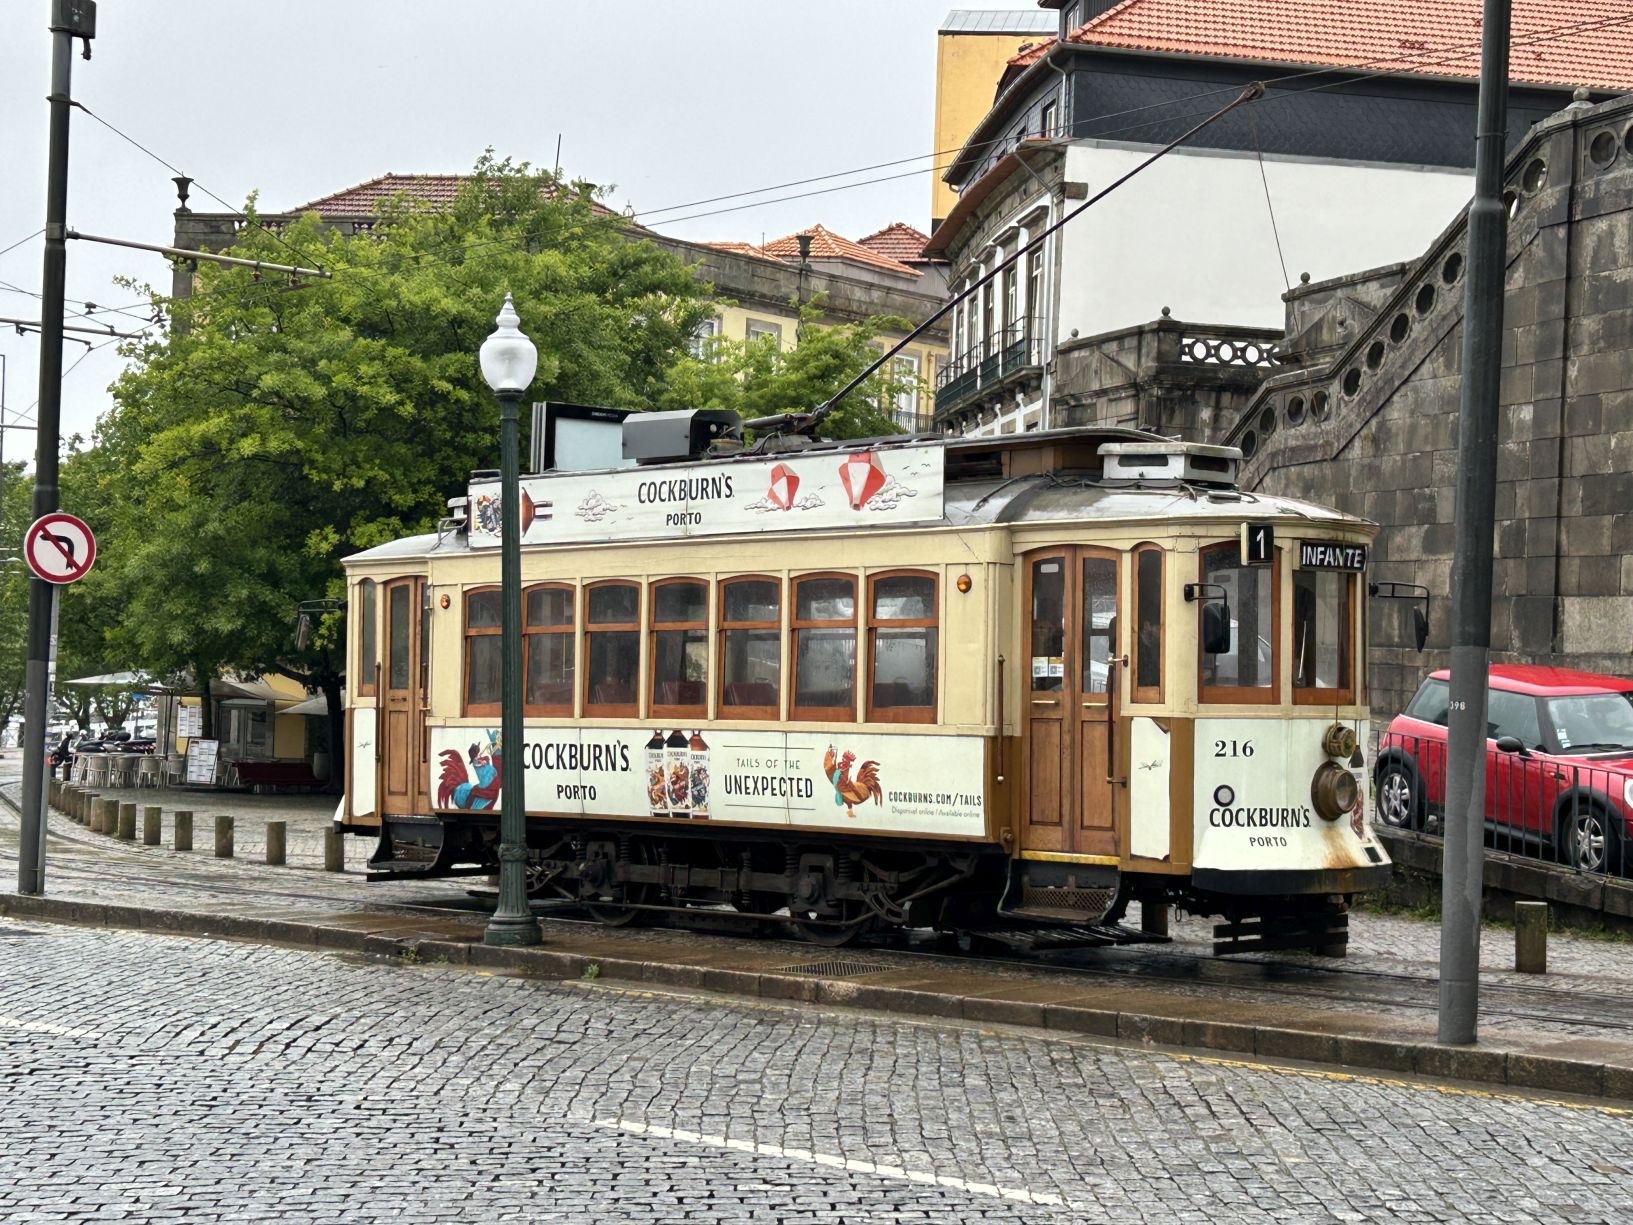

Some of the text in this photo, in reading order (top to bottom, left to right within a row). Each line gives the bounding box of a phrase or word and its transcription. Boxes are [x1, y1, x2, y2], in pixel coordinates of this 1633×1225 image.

[638, 472, 732, 504] COCKBURN'S
[666, 512, 702, 526] PORTO
[1256, 528, 1265, 559] 1
[1302, 545, 1362, 568] INFANTE
[523, 739, 630, 772] COCKBURN'S
[1214, 740, 1254, 757] 216
[737, 758, 801, 770] TAILS OF THE
[557, 784, 597, 800] PORTO
[724, 774, 813, 798] UNEXPECTED
[888, 791, 982, 807] COCKBURNS.COM/TAILS
[1209, 804, 1310, 828] COCKBURN'S
[1249, 837, 1288, 847] PORTO
